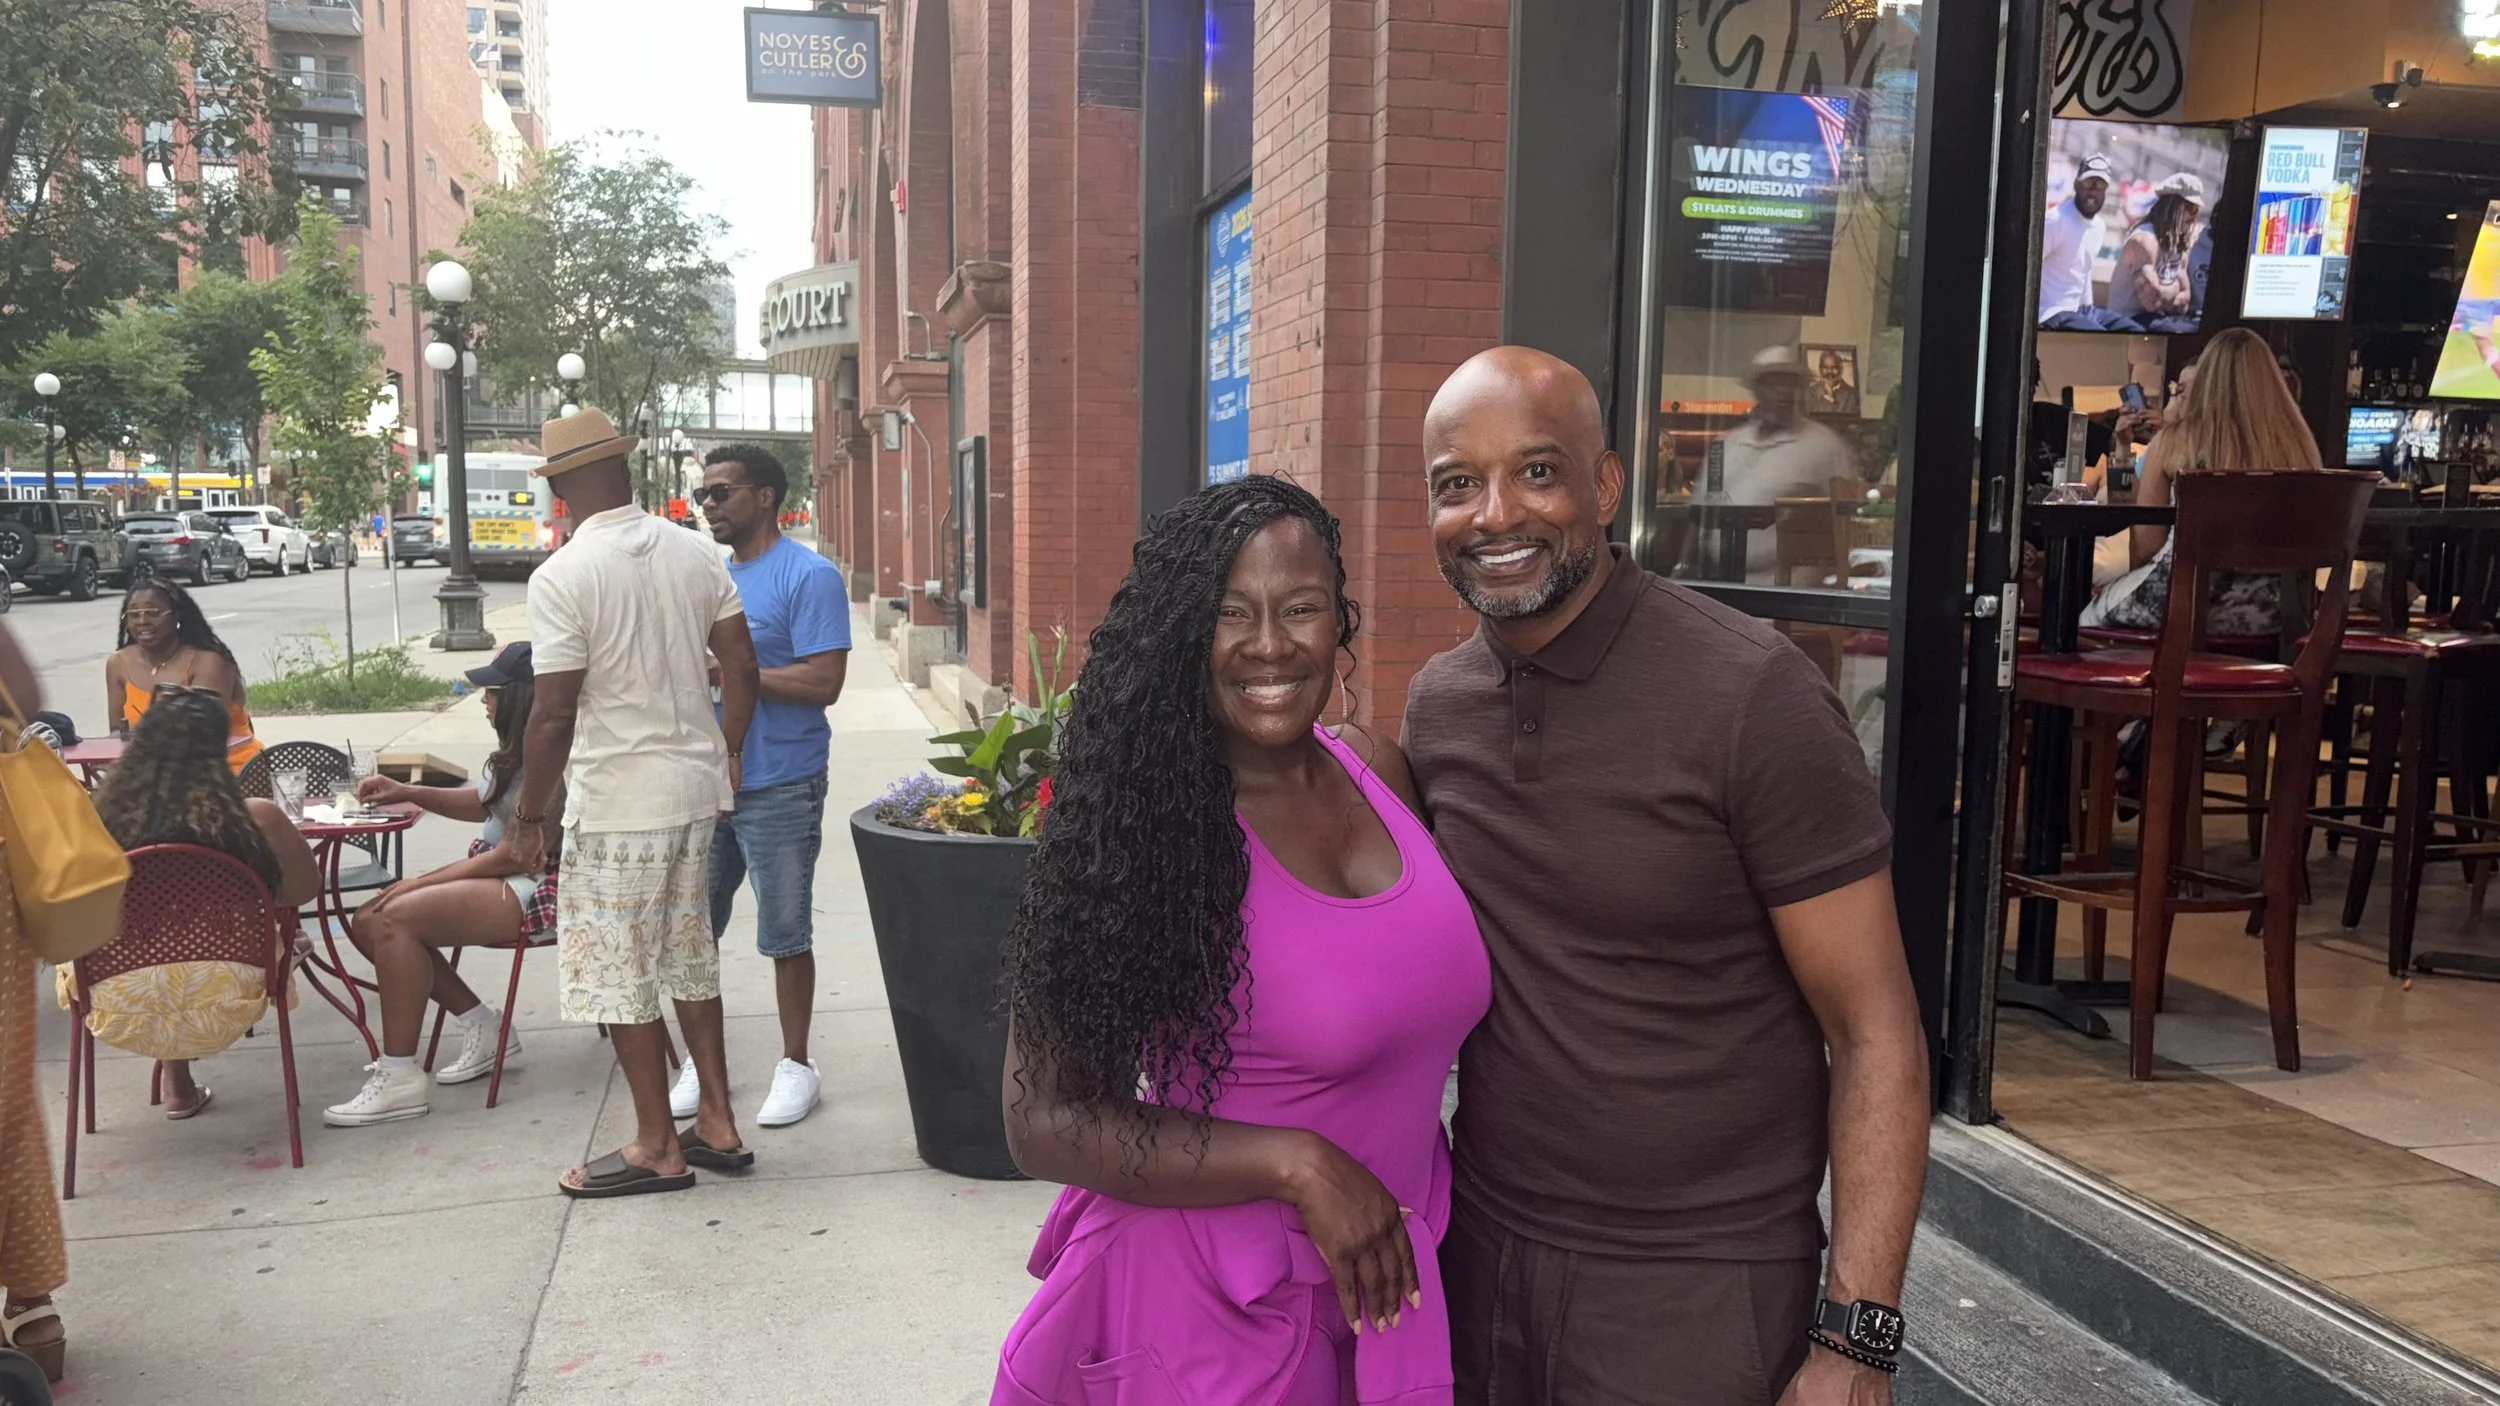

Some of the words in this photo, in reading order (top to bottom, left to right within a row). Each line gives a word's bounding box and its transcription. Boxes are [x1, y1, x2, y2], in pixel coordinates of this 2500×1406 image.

[759, 31, 832, 51] NOYES
[759, 50, 834, 69] CUTLER
[810, 71, 837, 79] park
[1693, 144, 1812, 179] WINGS
[2267, 152, 2293, 168] RED
[2294, 153, 2327, 169] BULL
[2265, 168, 2311, 184] VODKA
[1695, 176, 1807, 198] WEDNESDAY
[1691, 202, 1703, 213] $1
[1704, 203, 1737, 216] FLATS
[1738, 205, 1746, 215] &
[1747, 206, 1804, 219] DRUMMIES
[1720, 224, 1747, 235] HAPPY
[1747, 226, 1771, 236] HOUR
[769, 281, 846, 333] COURT
